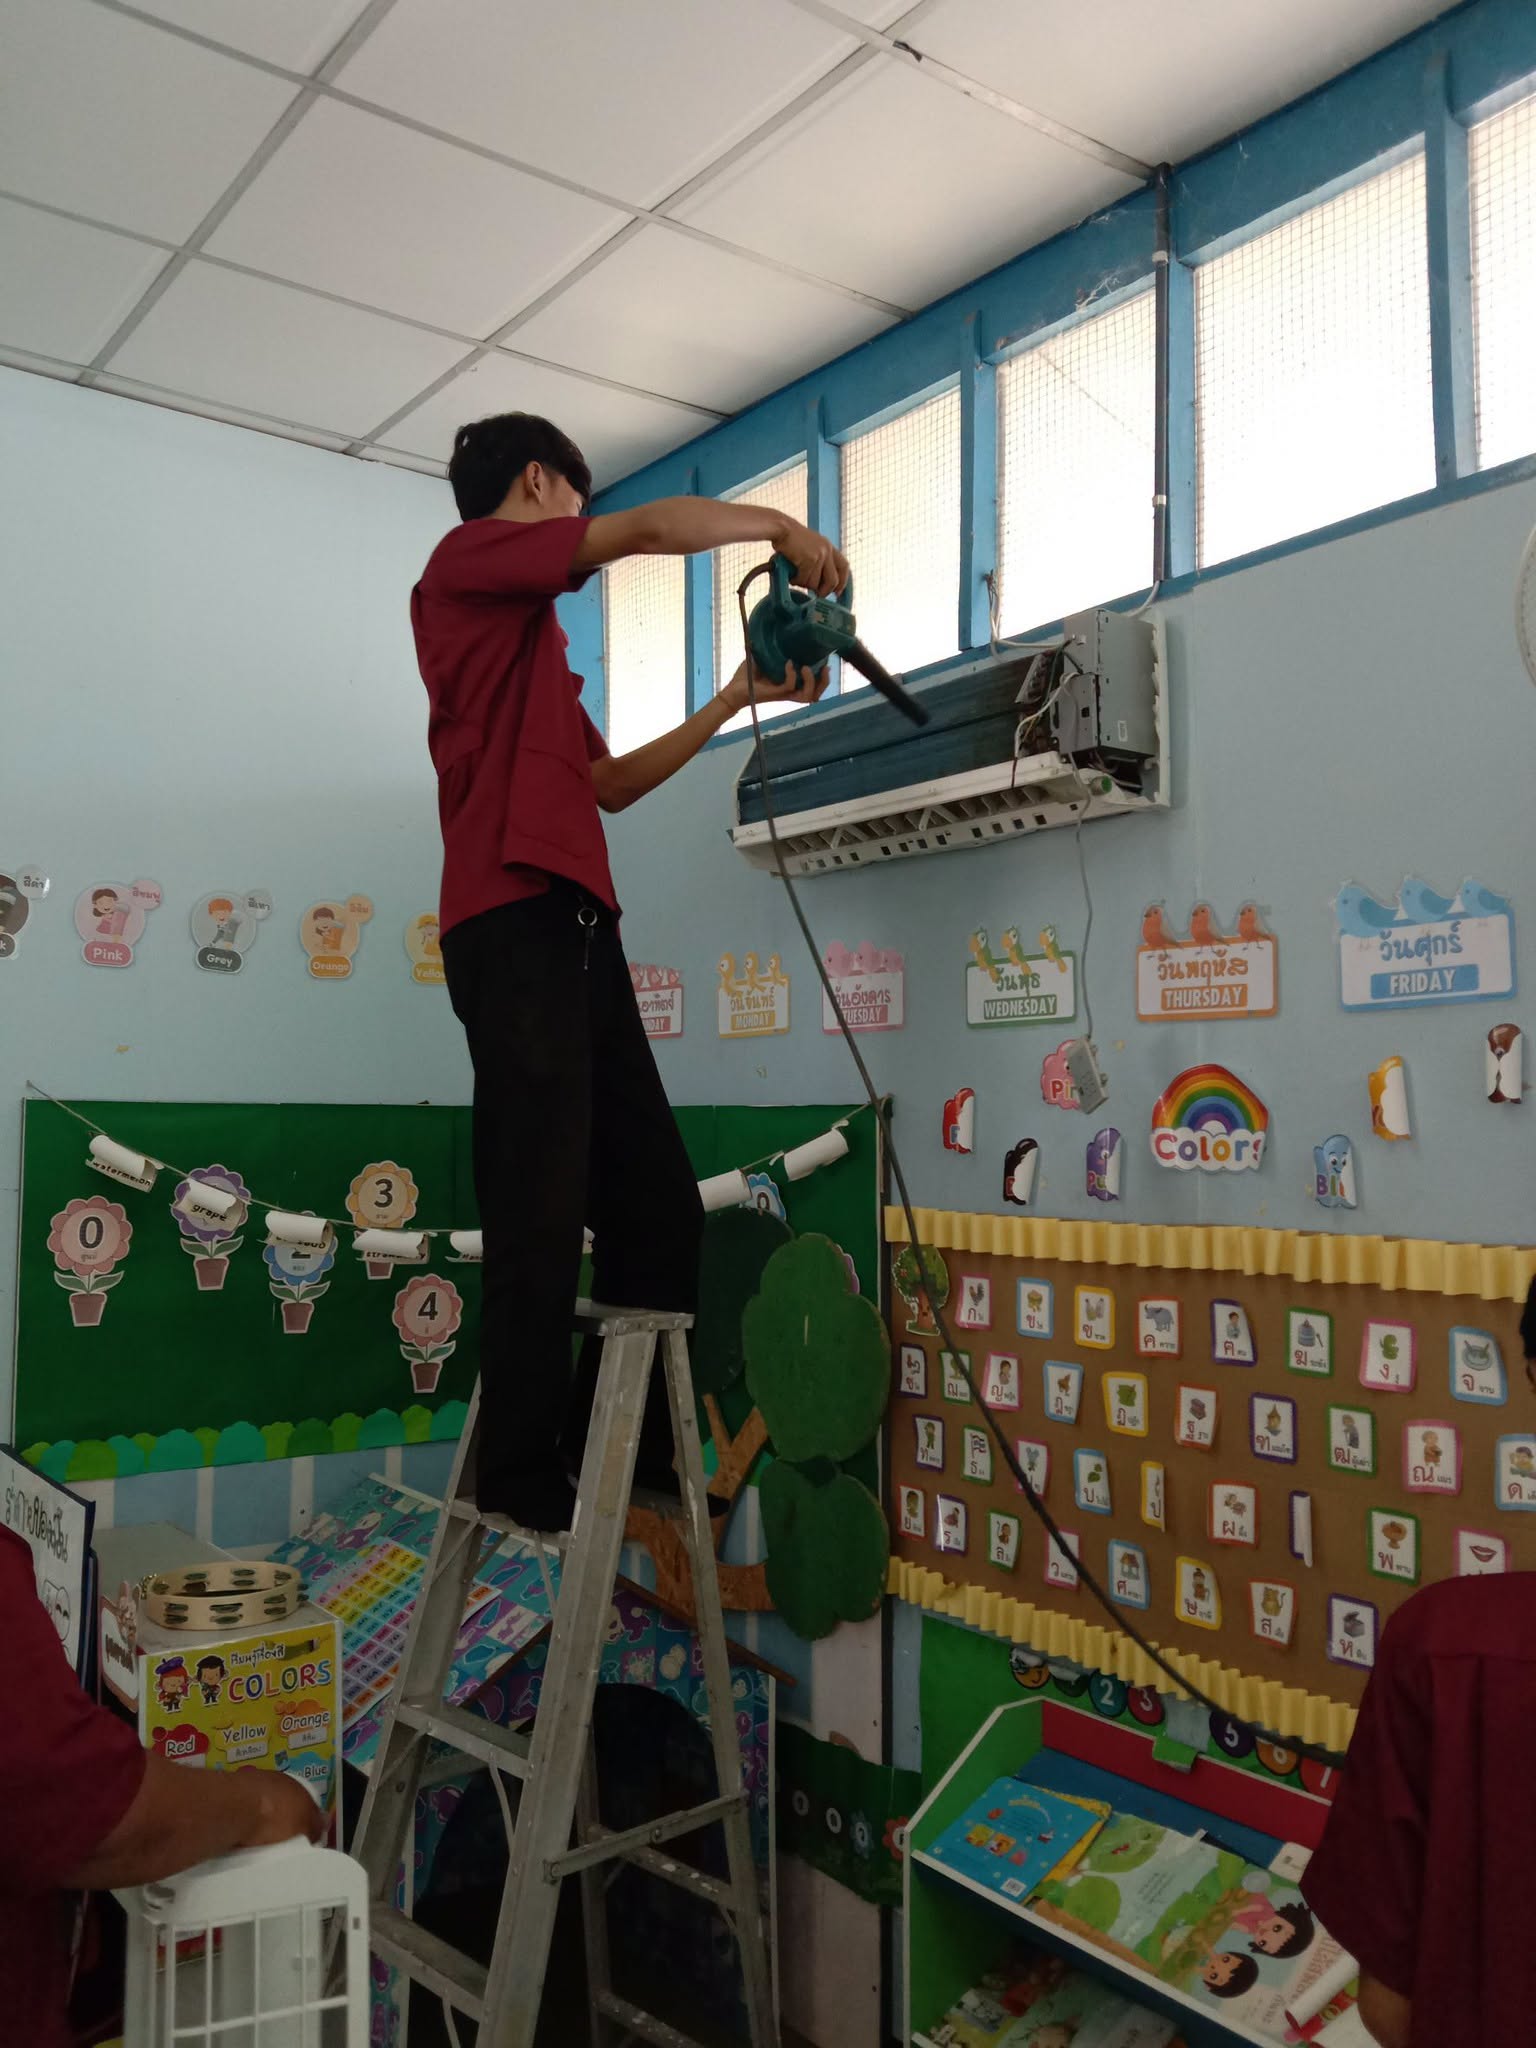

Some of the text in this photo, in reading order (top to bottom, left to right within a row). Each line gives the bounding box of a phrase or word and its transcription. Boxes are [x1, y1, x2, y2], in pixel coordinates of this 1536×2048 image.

[1379, 921, 1464, 966] วันศุกร์
[93, 947, 123, 961] Pink
[206, 953, 233, 968] Grey
[312, 961, 350, 974] Orange
[1157, 946, 1248, 987] วันพฤหัส
[996, 968, 1041, 997] วันพุธ
[1390, 969, 1456, 994] FRIDAY
[985, 996, 1056, 1019] WEDNESDAY
[1165, 988, 1245, 1010] THURSDAY
[736, 1011, 769, 1028] MONDAY
[842, 1006, 882, 1024] TUESDAY
[374, 1179, 393, 1207] 3
[191, 1203, 228, 1222] grape
[79, 1216, 104, 1249] 0
[418, 1292, 438, 1320] 4
[1379, 1363, 1390, 1380] ง
[1462, 1374, 1475, 1392] จ
[1413, 1466, 1434, 1482] ณ
[229, 1661, 331, 1701] COLORS
[1100, 1678, 1114, 1706] 2
[1138, 1687, 1153, 1711] 3
[282, 1712, 329, 1731] Orange
[223, 1726, 267, 1742] Yellow
[1224, 1721, 1239, 1748] 5
[167, 1736, 194, 1755] Red
[305, 1766, 328, 1777] Blue
